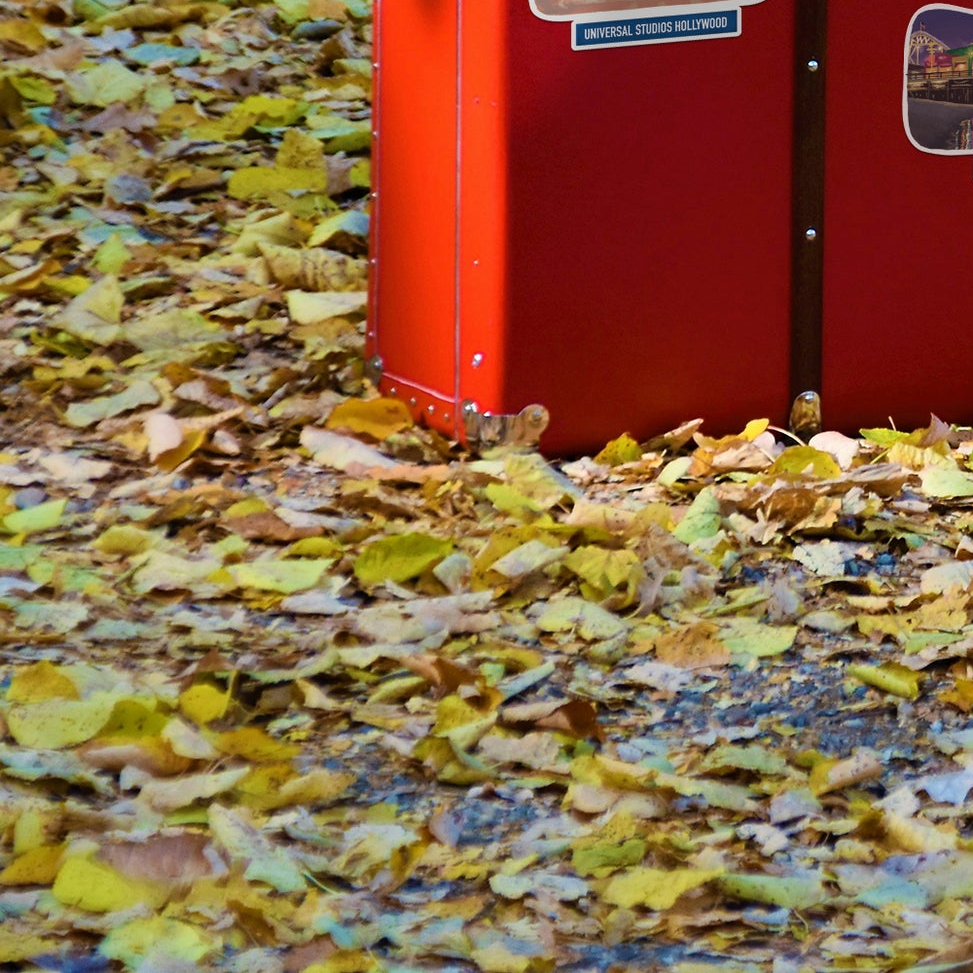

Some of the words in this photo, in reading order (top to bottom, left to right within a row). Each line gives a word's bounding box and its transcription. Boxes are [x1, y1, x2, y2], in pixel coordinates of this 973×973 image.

[584, 25, 633, 40] UNIVERSAL
[635, 21, 673, 35] STUDIOS
[674, 16, 728, 31] HOLLYWOOD
